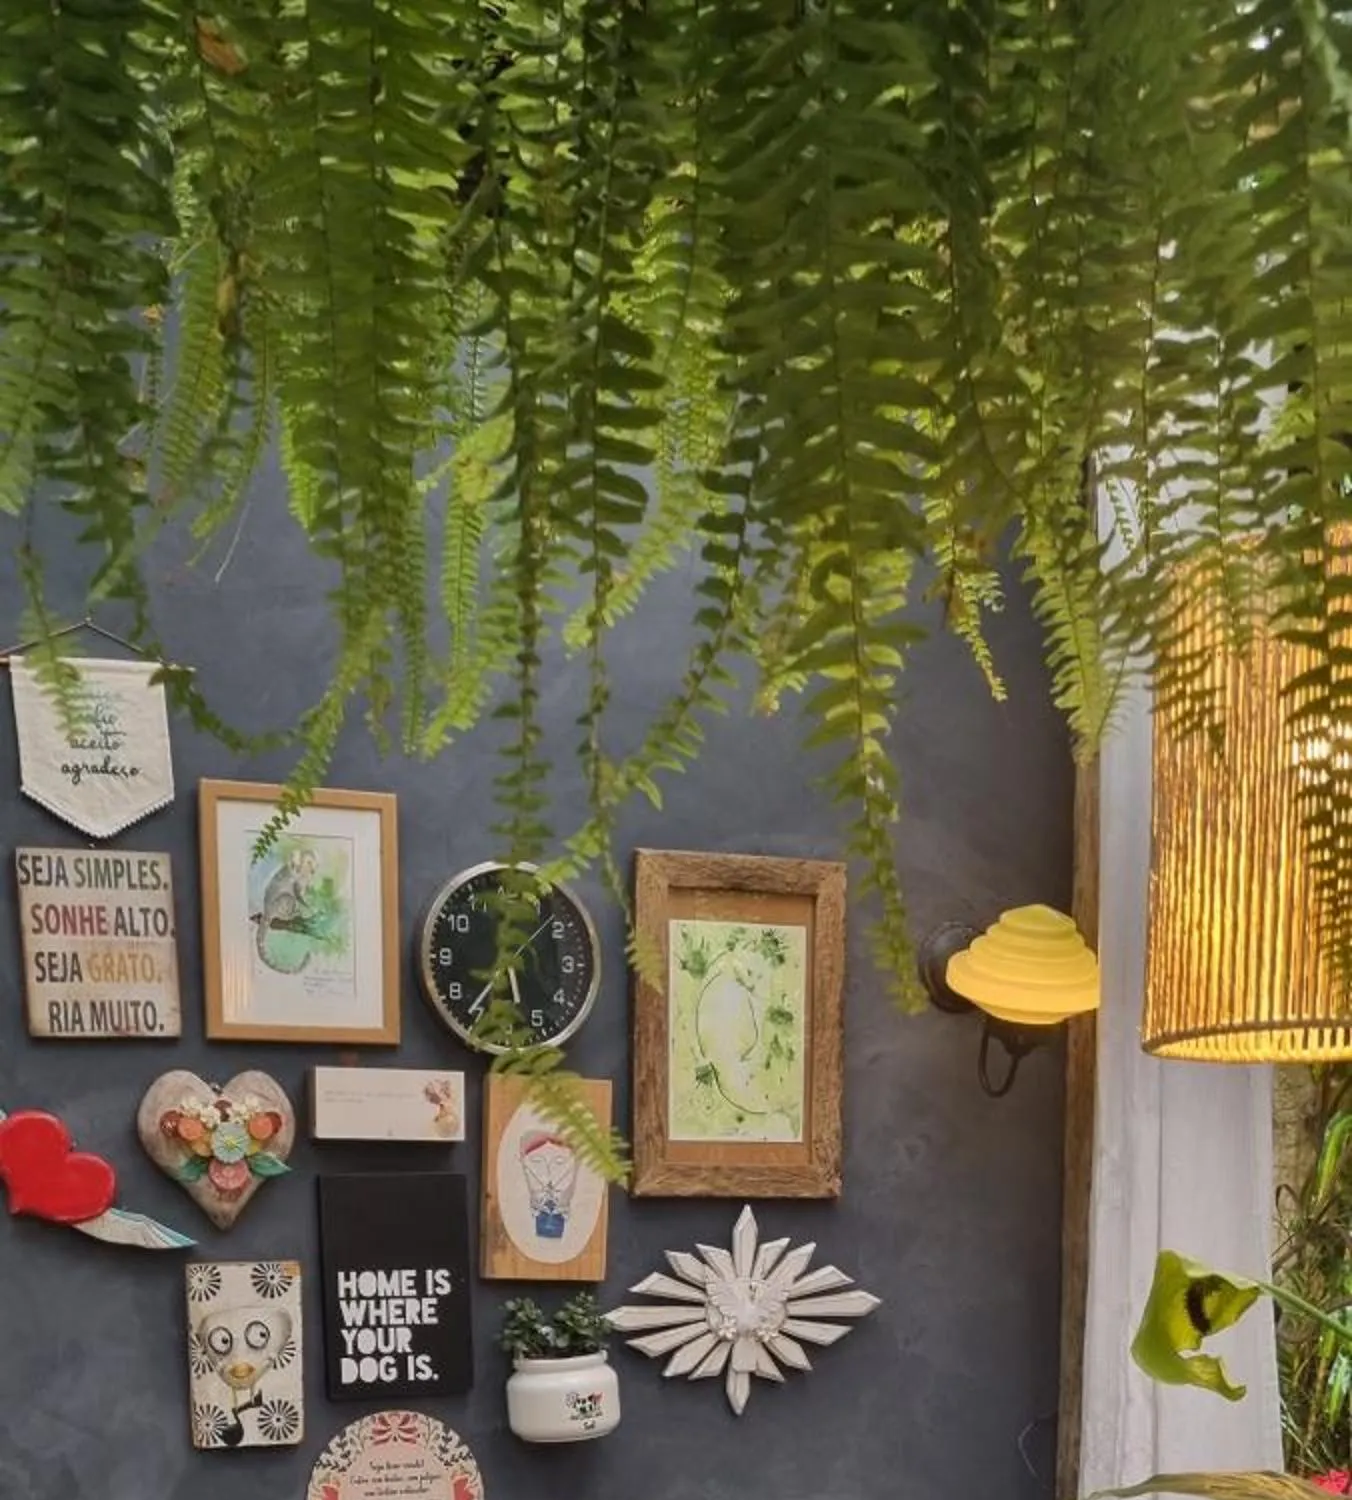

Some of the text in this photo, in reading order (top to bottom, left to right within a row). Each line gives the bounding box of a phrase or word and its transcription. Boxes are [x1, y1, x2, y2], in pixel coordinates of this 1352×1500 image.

[17, 854, 169, 891] SEJA SIMPLES.
[30, 903, 176, 937] SONHE ALTO.
[447, 914, 469, 933] 10
[551, 921, 564, 939] 2
[34, 951, 163, 983] SEJA GRATO.
[439, 948, 452, 965] 9
[561, 955, 575, 973] 3
[449, 982, 462, 999] 8
[553, 988, 565, 1004] 4
[49, 1000, 165, 1033] RIA MUITO.
[531, 1009, 544, 1027] 5
[337, 1268, 452, 1298] HOME IS
[338, 1298, 439, 1327] WHERE
[340, 1327, 413, 1355] YOUR
[340, 1354, 440, 1384] DOG IS.
